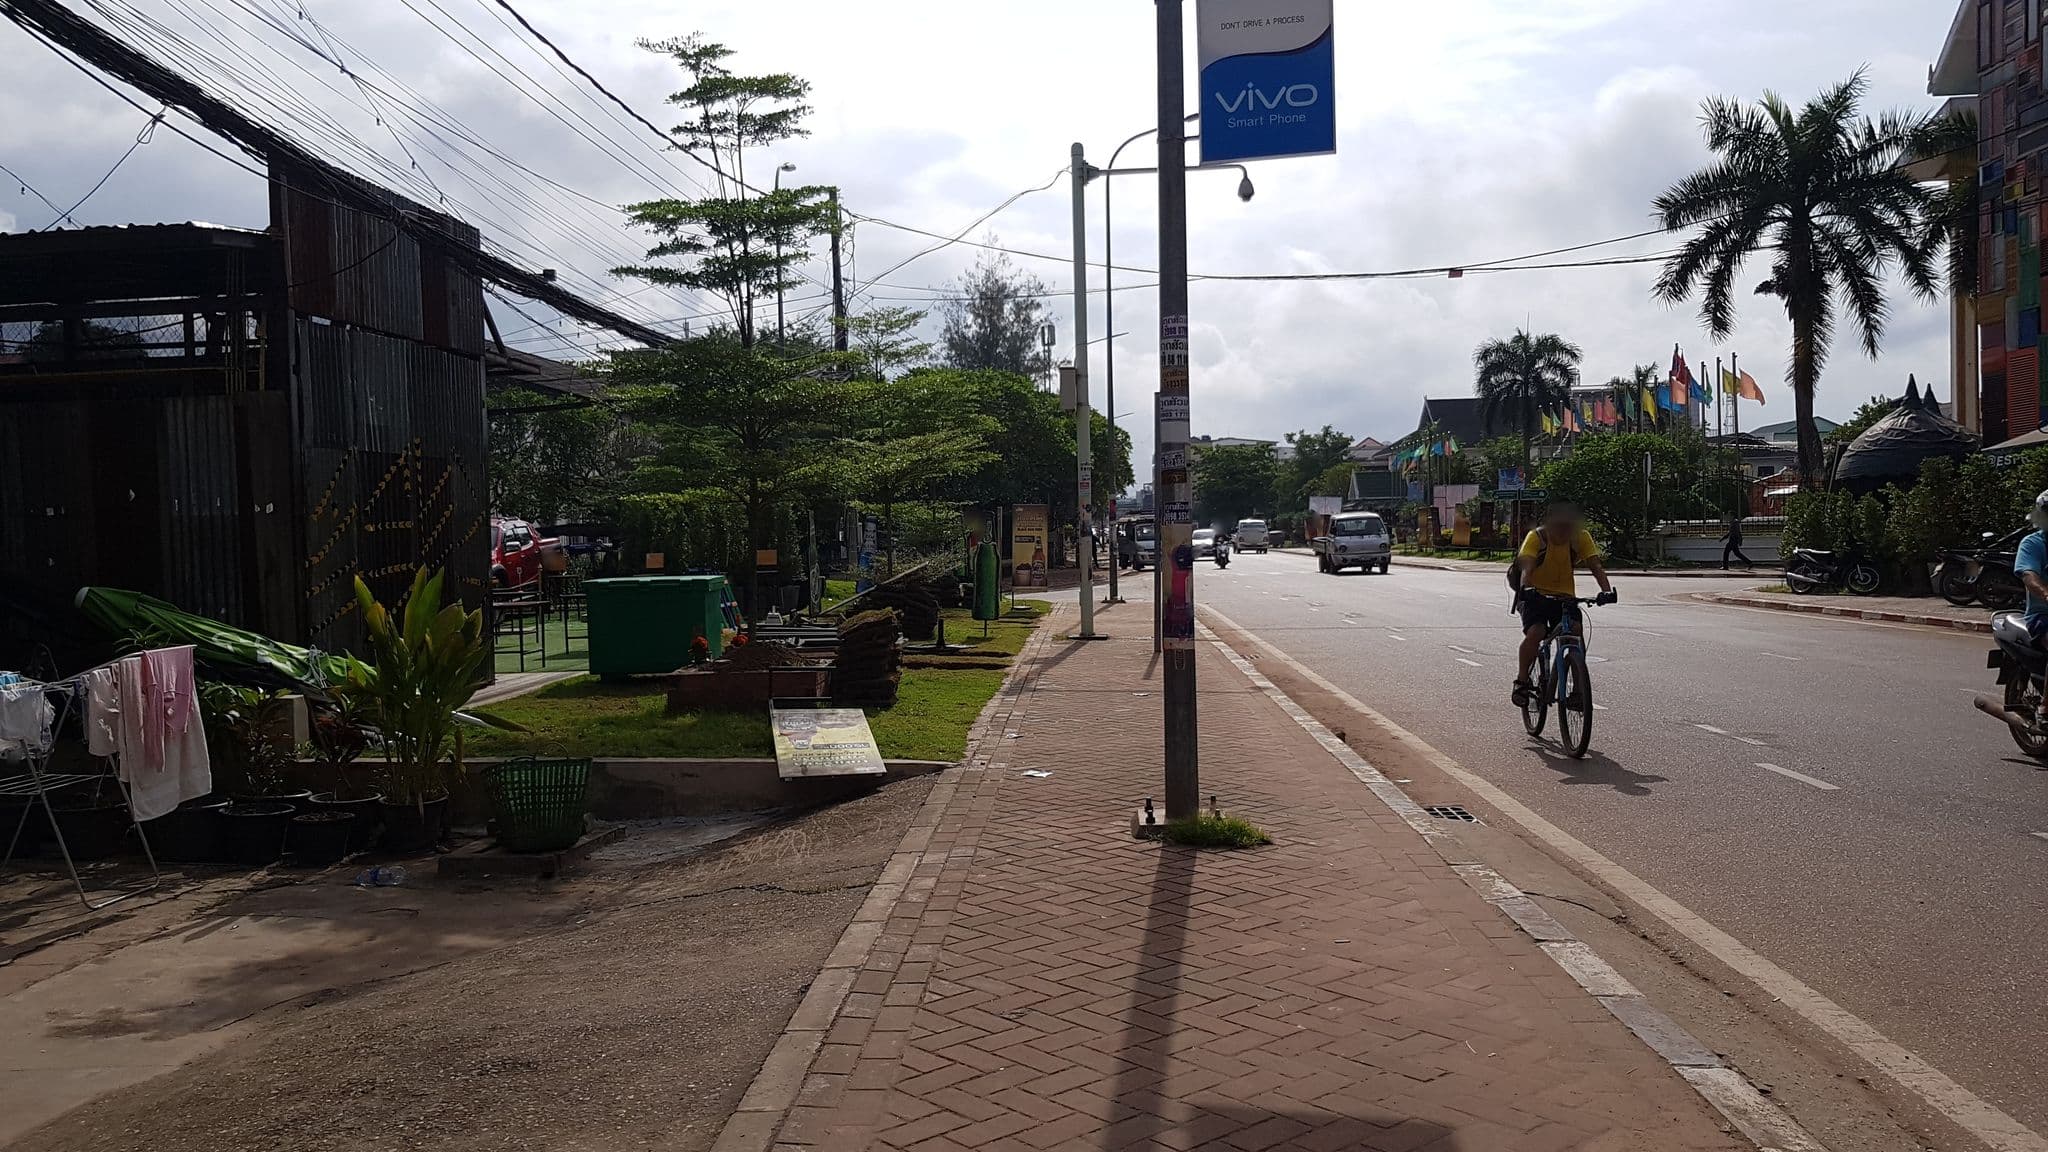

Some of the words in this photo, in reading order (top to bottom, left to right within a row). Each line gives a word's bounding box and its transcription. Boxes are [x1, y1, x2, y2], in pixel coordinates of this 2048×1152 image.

[1220, 21, 1240, 30] DON'T
[1243, 19, 1263, 28] DRIVE
[1273, 15, 1305, 25] PROCESS
[1215, 81, 1318, 113] vivo
[1227, 116, 1264, 129] Smart
[1269, 113, 1306, 126] Phone
